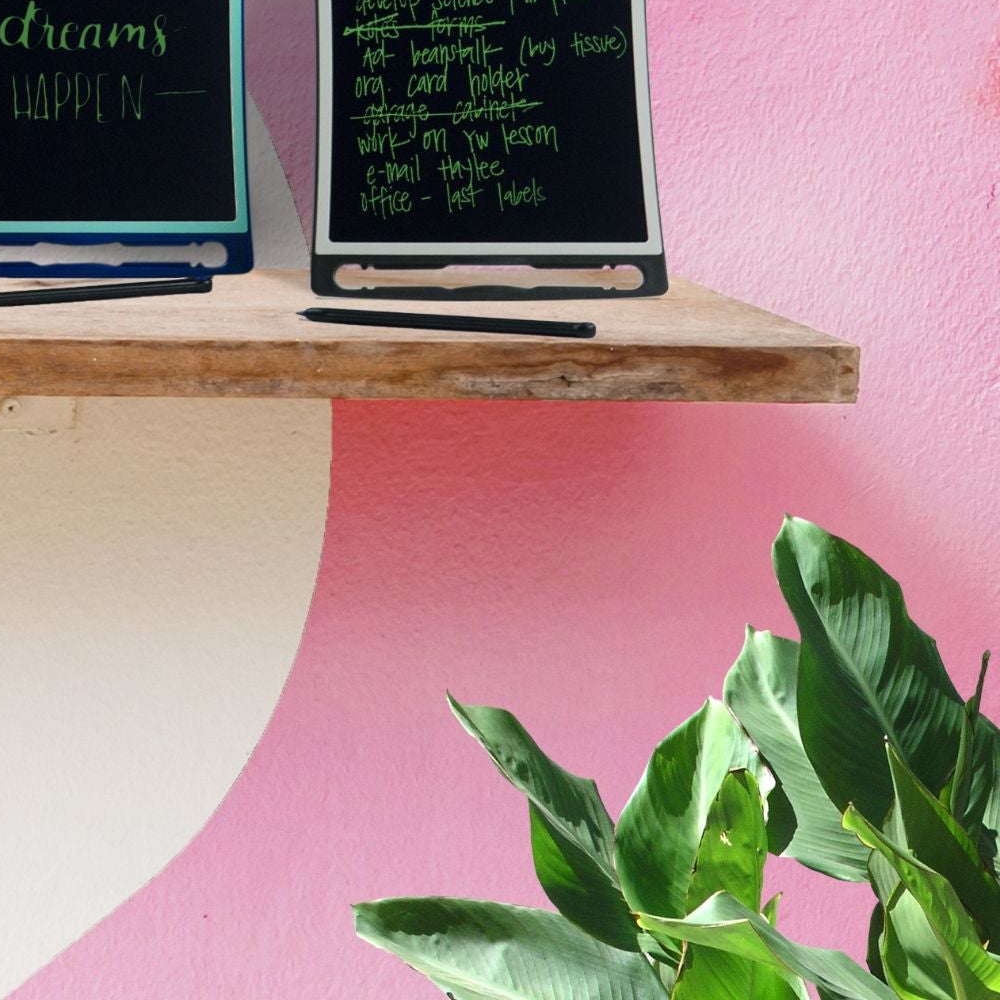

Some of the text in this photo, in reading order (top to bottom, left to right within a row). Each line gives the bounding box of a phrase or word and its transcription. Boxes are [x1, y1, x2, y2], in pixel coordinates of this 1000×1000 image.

[0, 0, 168, 57] dreams
[410, 34, 504, 69] beanstalk
[520, 34, 557, 67] (buy
[570, 24, 628, 60] tissue)
[11, 72, 145, 123] HAPPEN
[407, 65, 449, 98] card
[468, 64, 531, 104] holder
[357, 126, 411, 160] work
[423, 127, 448, 153] on
[502, 123, 559, 155] lesson
[366, 153, 505, 190] e-mail Haylee
[360, 185, 412, 220] office
[446, 181, 485, 213] last
[498, 177, 547, 212] labels
